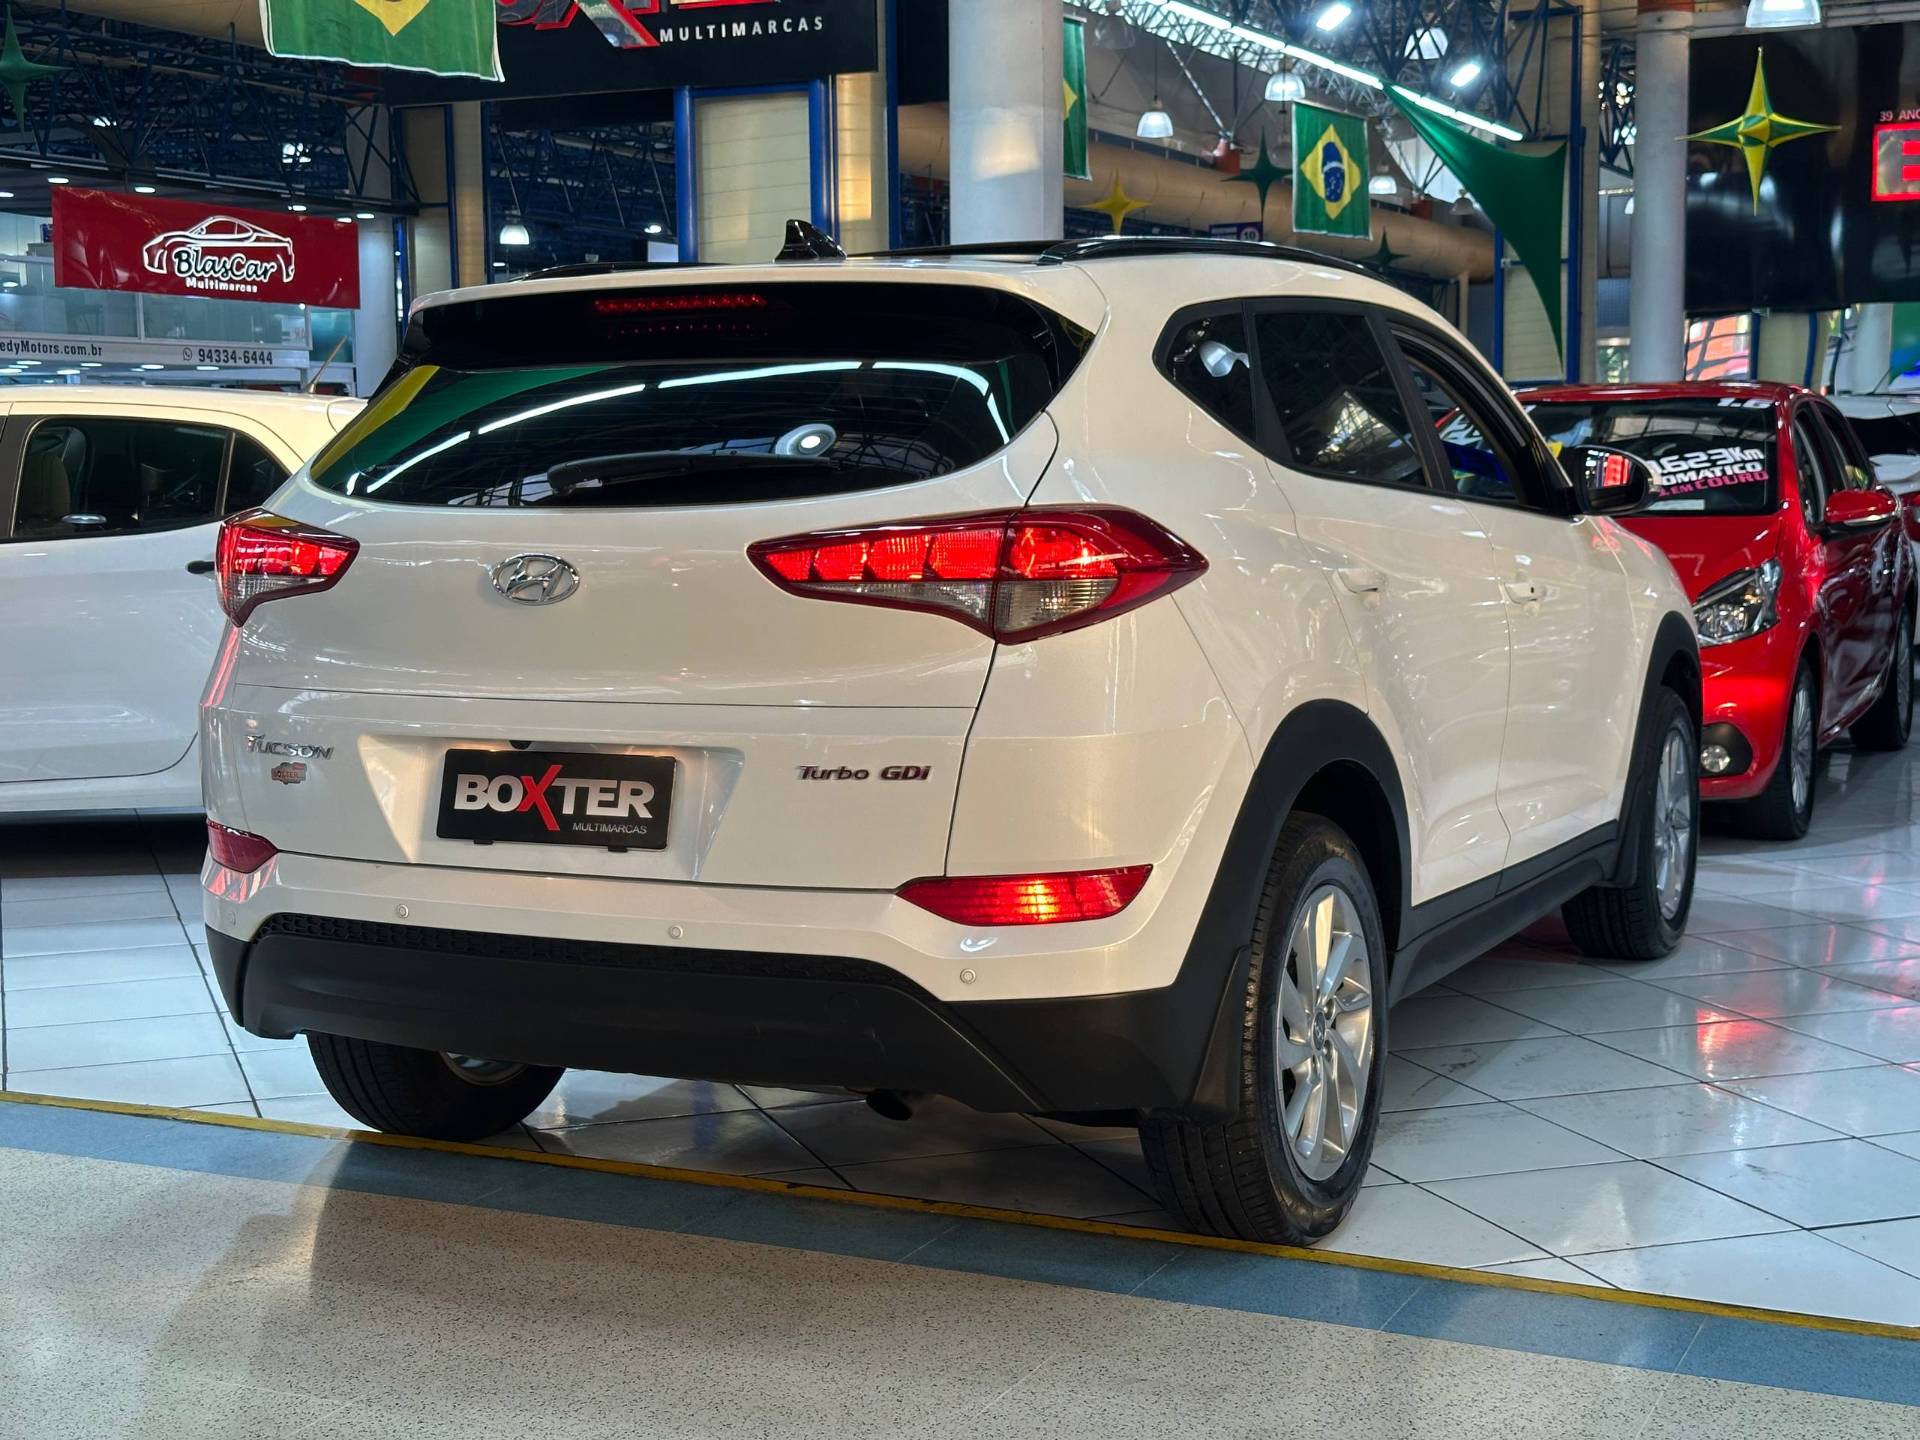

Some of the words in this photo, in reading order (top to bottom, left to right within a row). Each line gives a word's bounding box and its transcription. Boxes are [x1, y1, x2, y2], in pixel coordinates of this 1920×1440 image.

[659, 16, 825, 43] MULTIMARCAS
[1879, 111, 1893, 122] 39
[172, 247, 277, 282] BlasCar
[185, 277, 258, 293] Multimarcas
[198, 348, 273, 365] 94334-6444
[1661, 461, 1763, 486] OMATICO
[1695, 470, 1769, 490] COURO
[797, 764, 871, 781] Turbo
[879, 764, 933, 781] GDi
[453, 763, 653, 832] BOXTER
[572, 821, 649, 835] MULTIMARCAS
